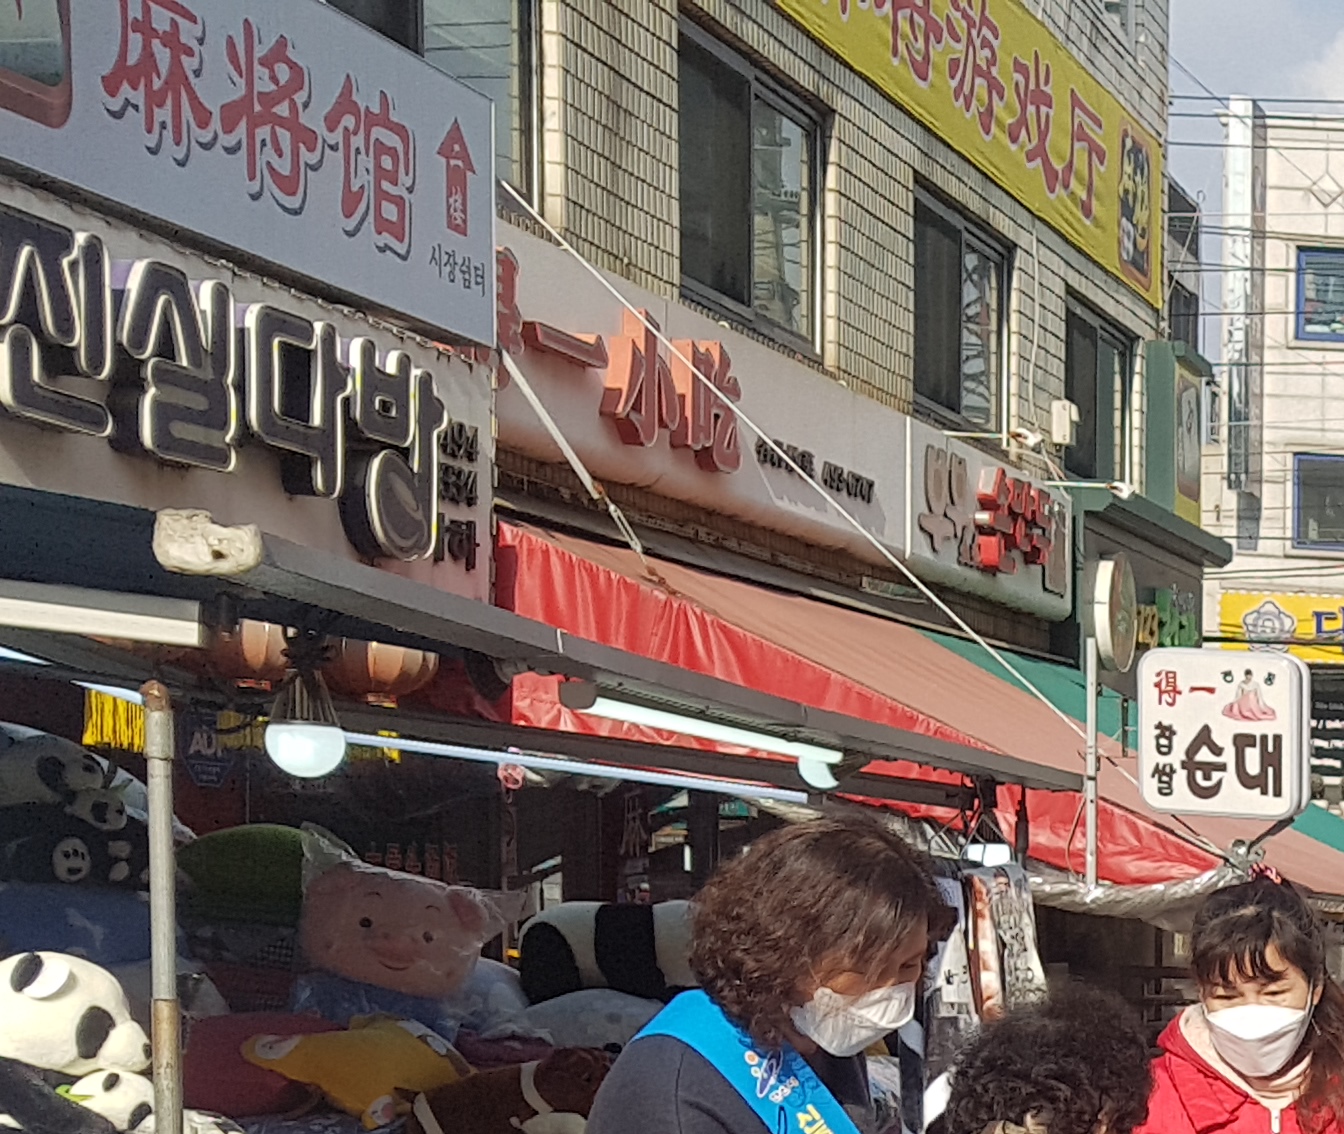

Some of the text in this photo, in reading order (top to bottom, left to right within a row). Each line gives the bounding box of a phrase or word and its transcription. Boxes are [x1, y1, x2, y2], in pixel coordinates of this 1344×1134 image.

[101, 0, 414, 252] 麻将馆
[838, 0, 1108, 224] 将游戏厅
[0, 205, 449, 561] 진실다방
[1153, 669, 1217, 707] 得一
[1180, 723, 1283, 799] 순대
